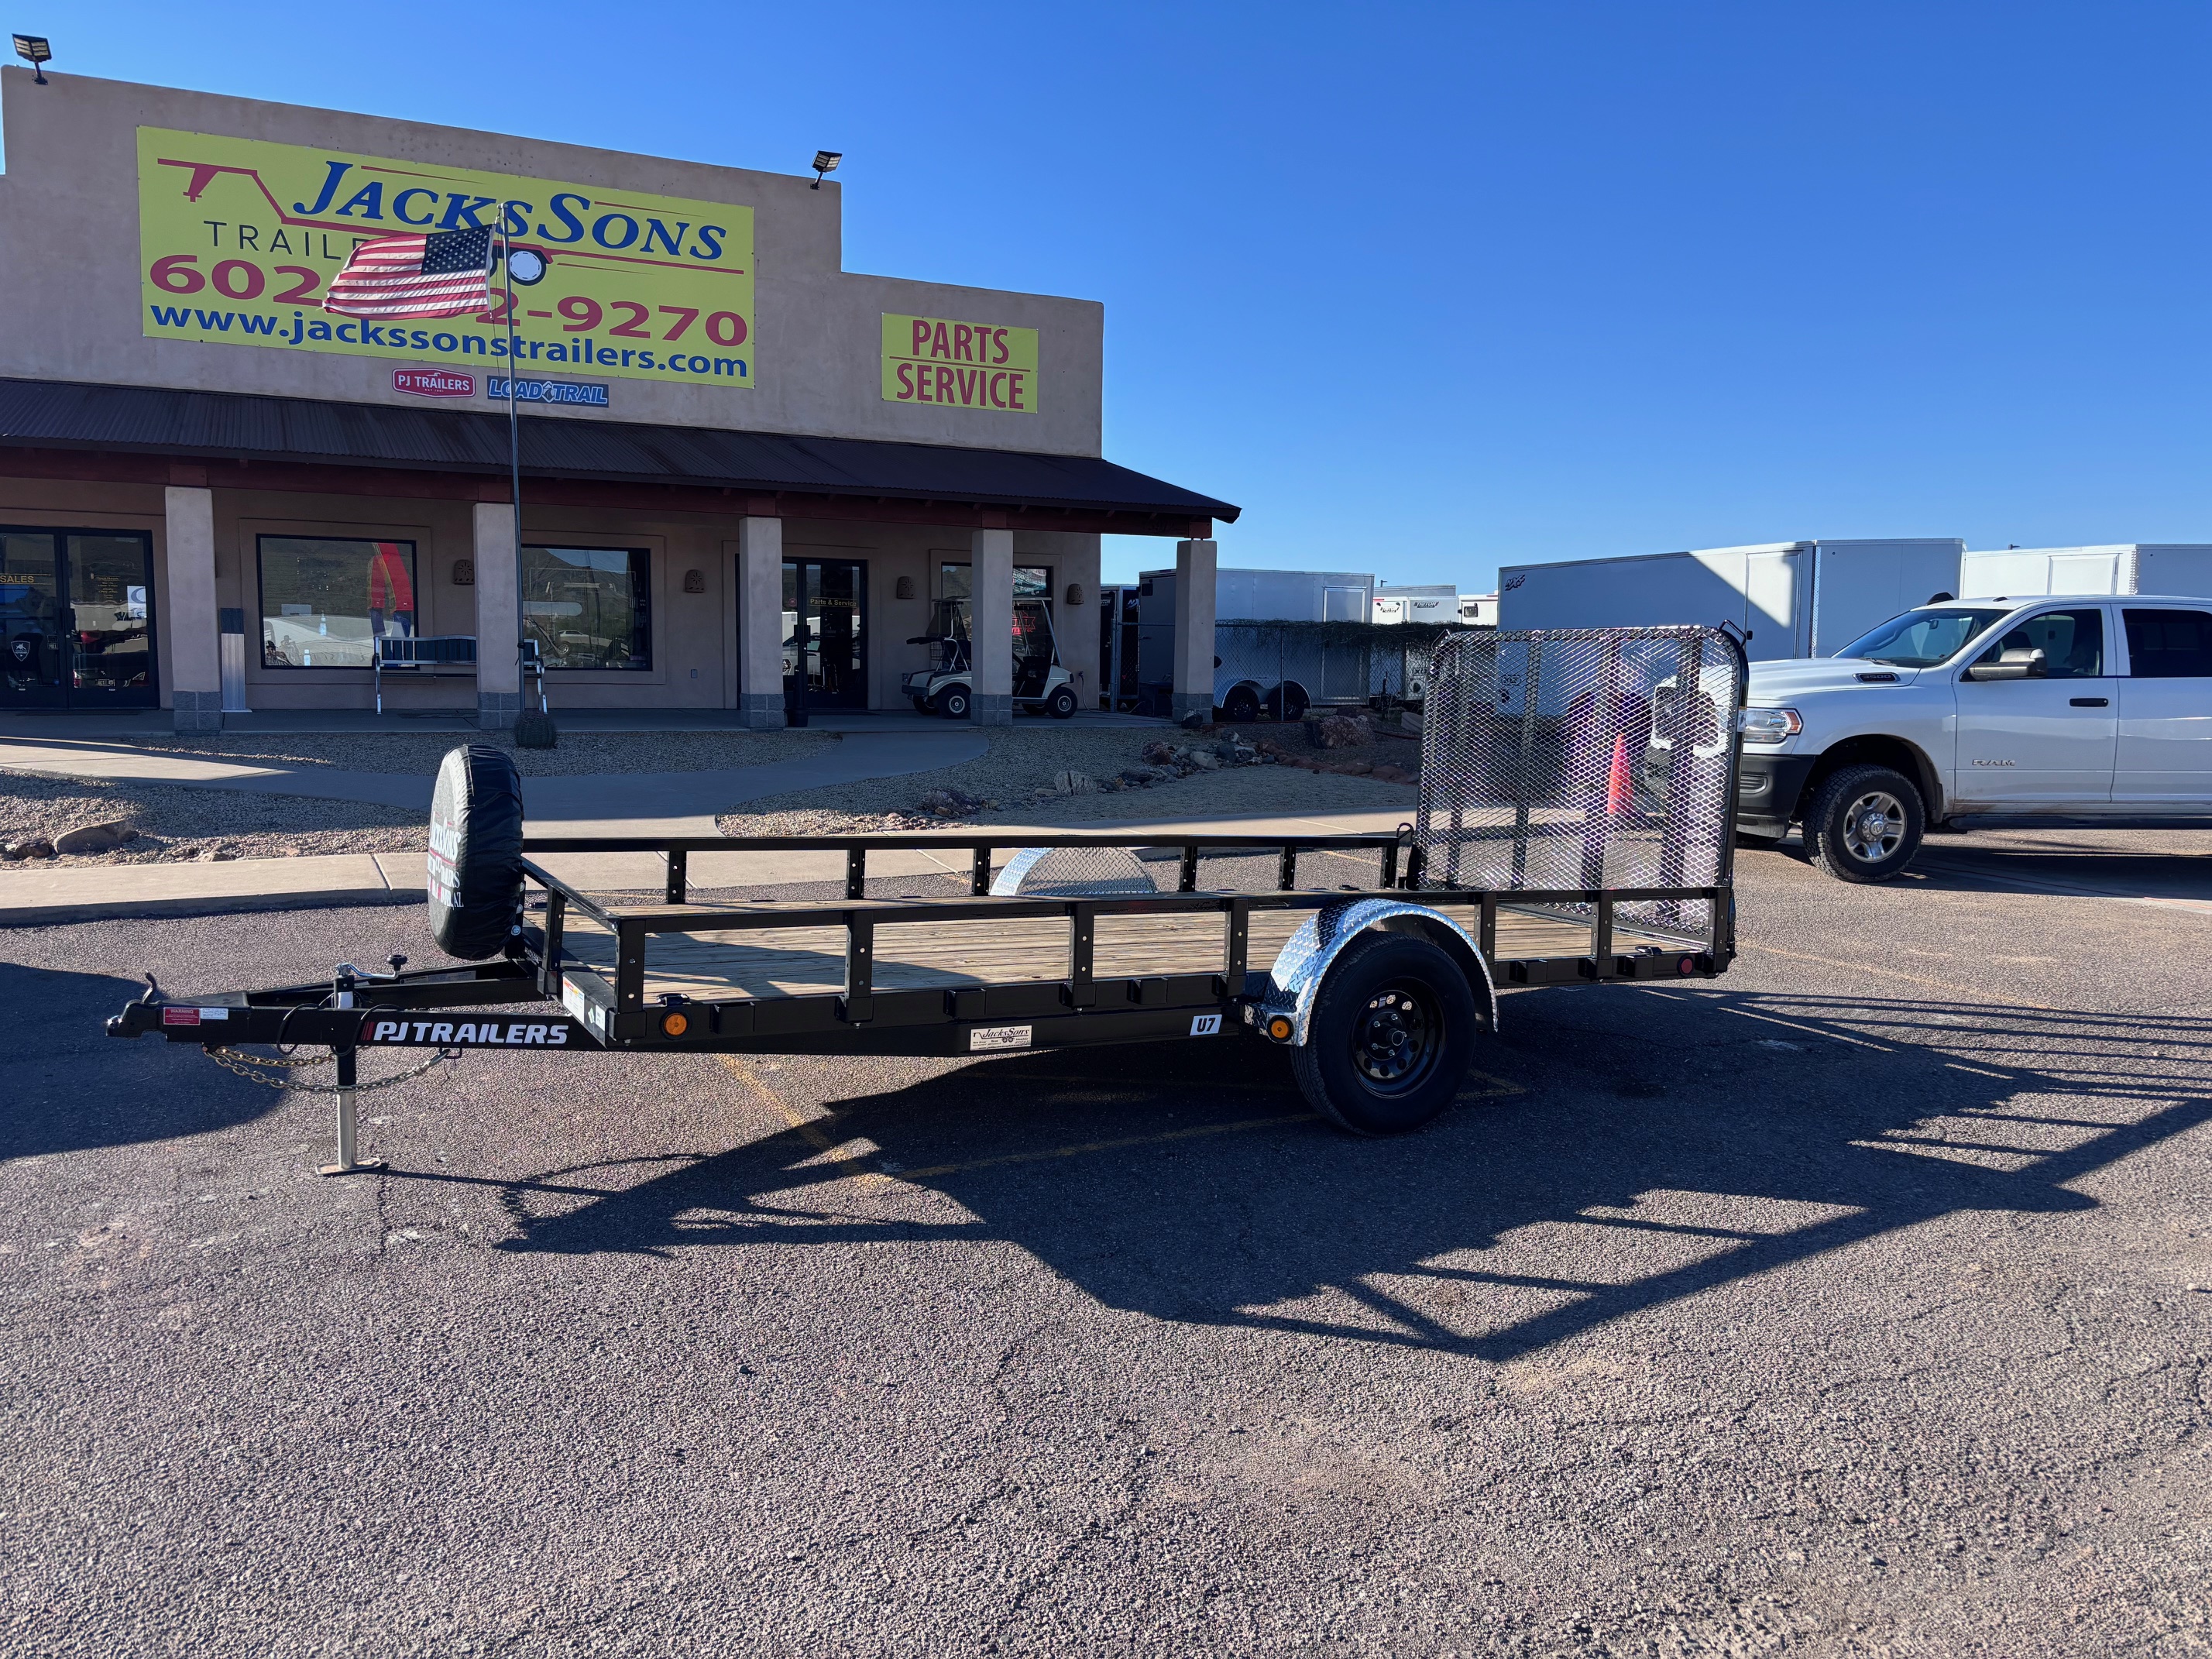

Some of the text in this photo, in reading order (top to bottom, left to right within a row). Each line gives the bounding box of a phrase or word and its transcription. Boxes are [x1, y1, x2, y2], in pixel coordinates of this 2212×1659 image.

[150, 304, 748, 378] www.jackssonstrailers.com
[912, 319, 1009, 364] PARTS
[398, 375, 470, 391] PJ TRAILERS
[489, 379, 608, 404] LOAD TRAIL
[896, 362, 1024, 410] SERVICE
[0, 575, 35, 583] SALES
[373, 1022, 569, 1044] PJ TRAILERS
[1196, 1017, 1216, 1032] U7
